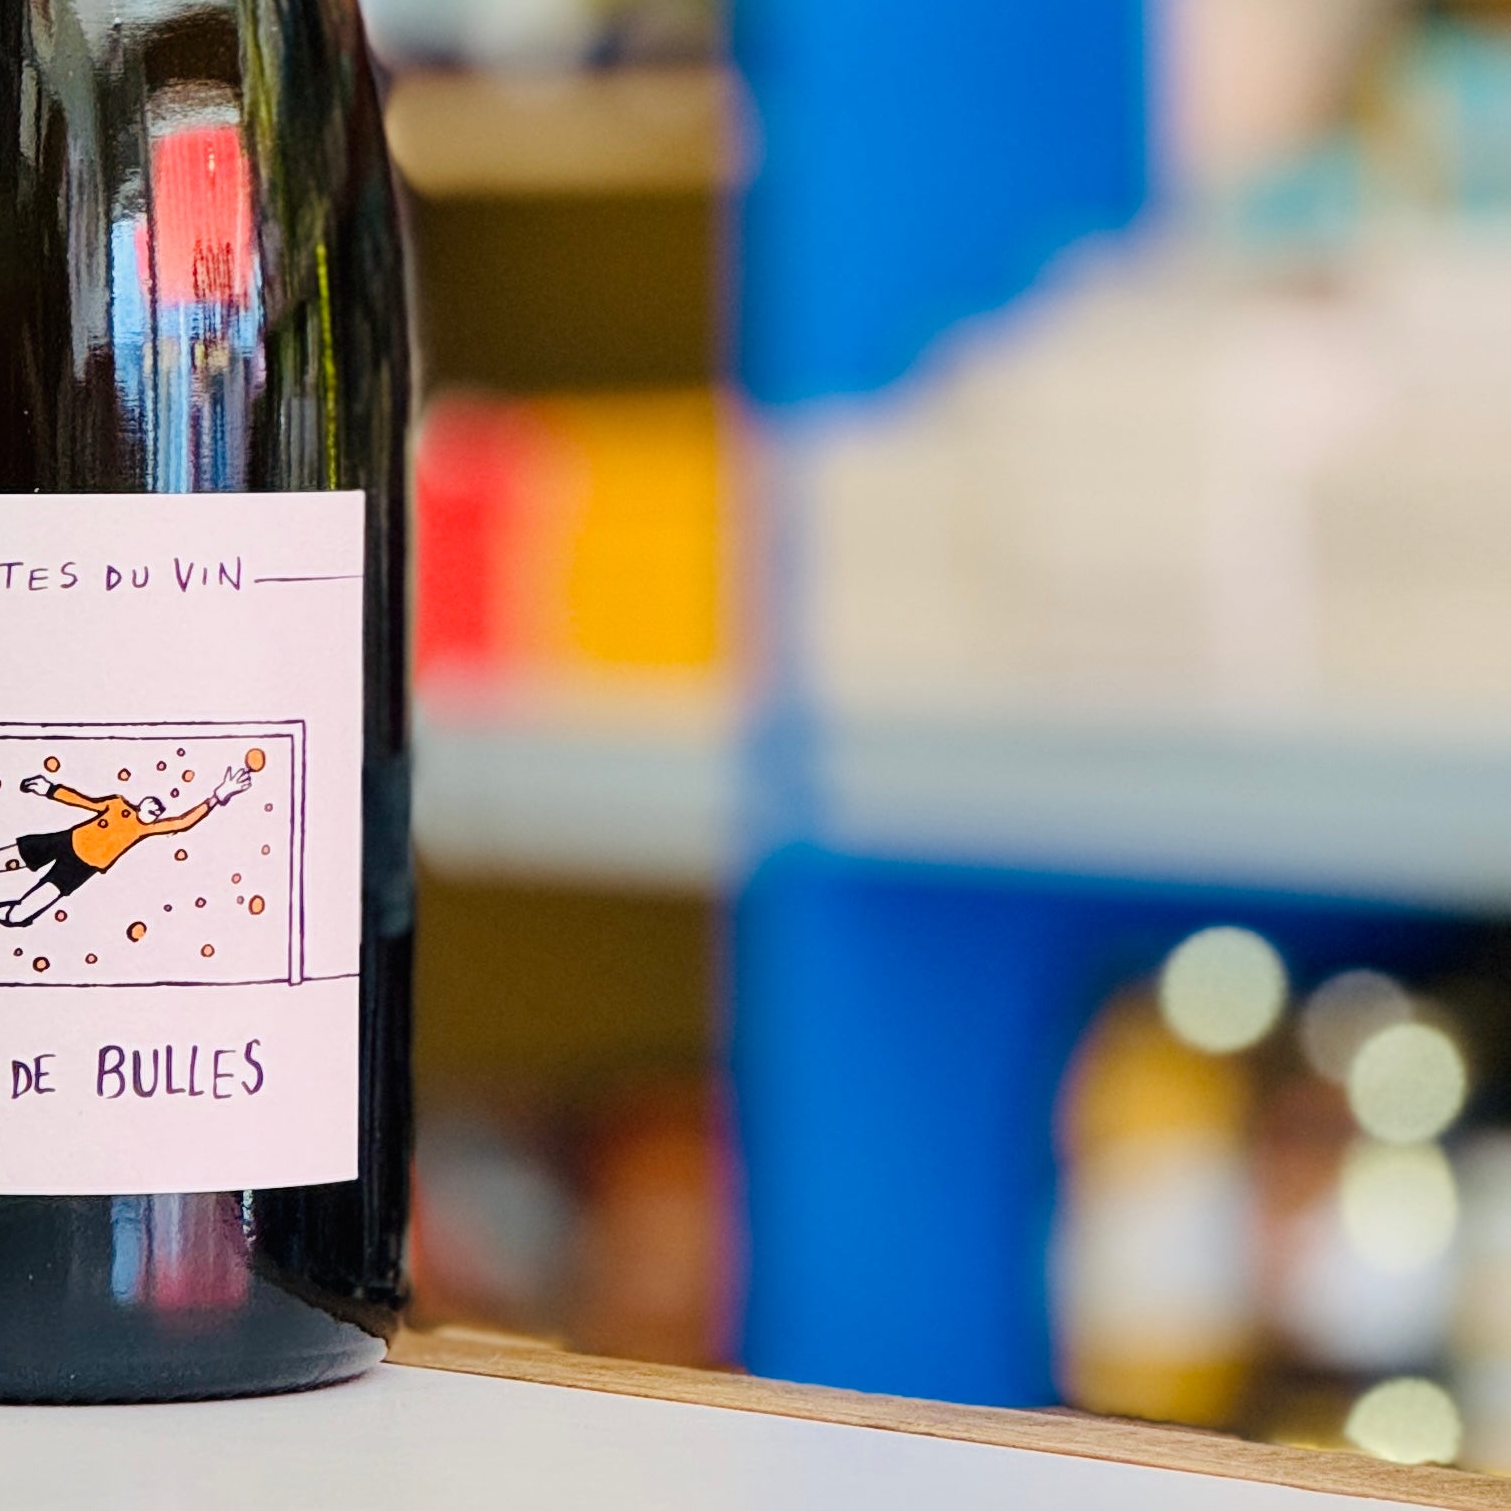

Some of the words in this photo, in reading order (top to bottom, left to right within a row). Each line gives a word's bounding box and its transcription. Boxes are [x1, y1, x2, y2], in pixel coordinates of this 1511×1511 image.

[106, 565, 148, 591] DU
[175, 557, 240, 592] VIN
[12, 1054, 55, 1099] DE
[97, 1039, 263, 1099] BULLES
